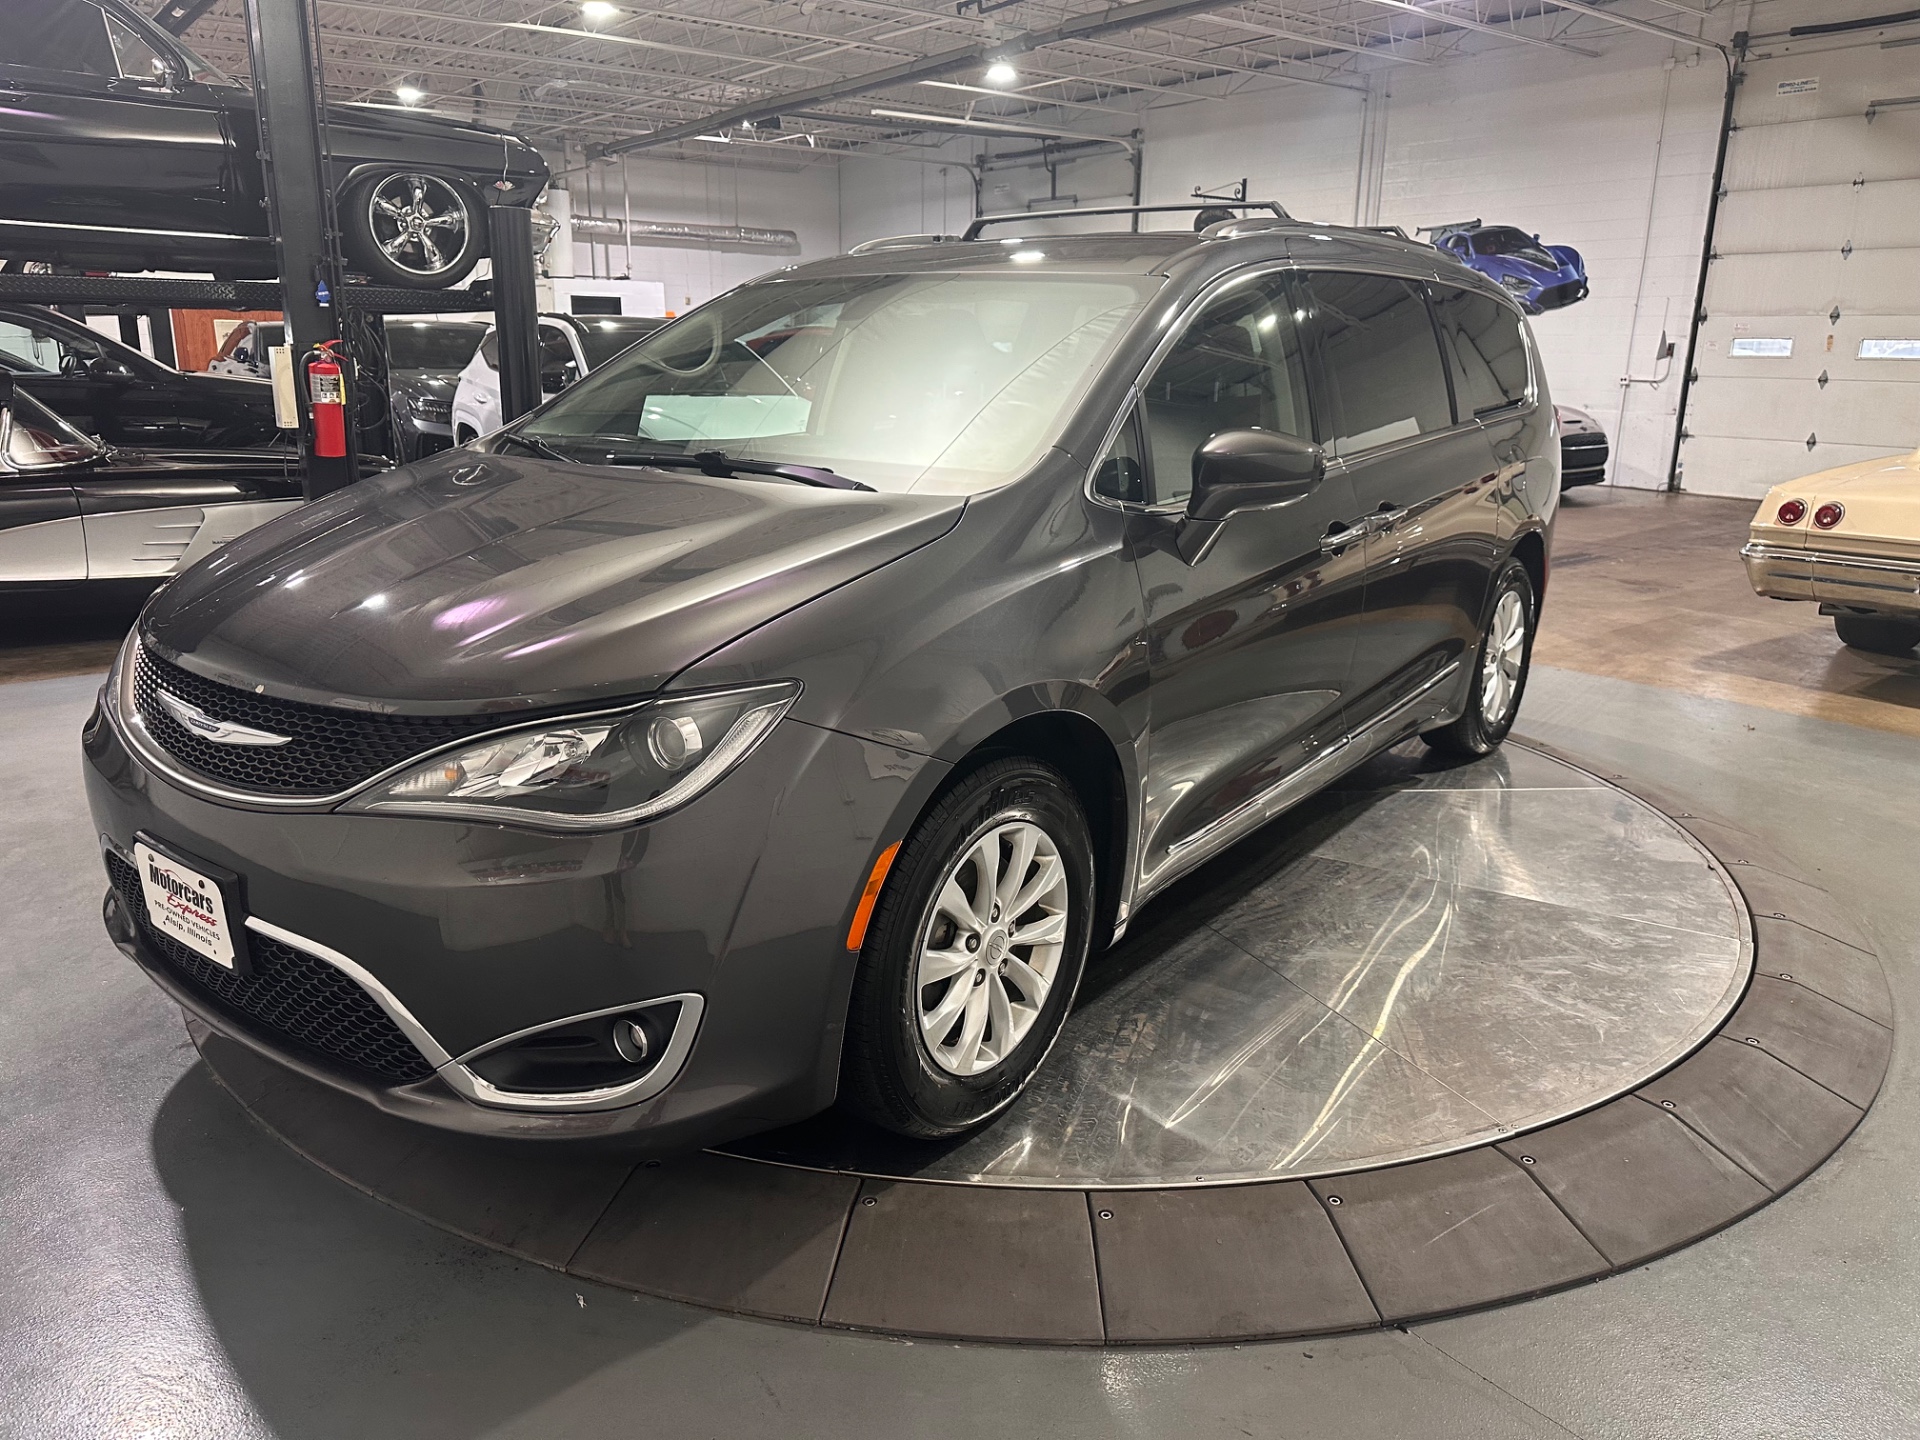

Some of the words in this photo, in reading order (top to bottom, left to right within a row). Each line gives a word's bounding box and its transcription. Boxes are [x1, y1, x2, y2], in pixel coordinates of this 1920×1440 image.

[149, 863, 213, 914] Motorcars
[154, 900, 191, 924] PRE-OWNED
[191, 919, 220, 941] VEHICLES
[167, 893, 217, 927] Express
[164, 915, 186, 932] Alsip,
[187, 926, 212, 946] Illinois
